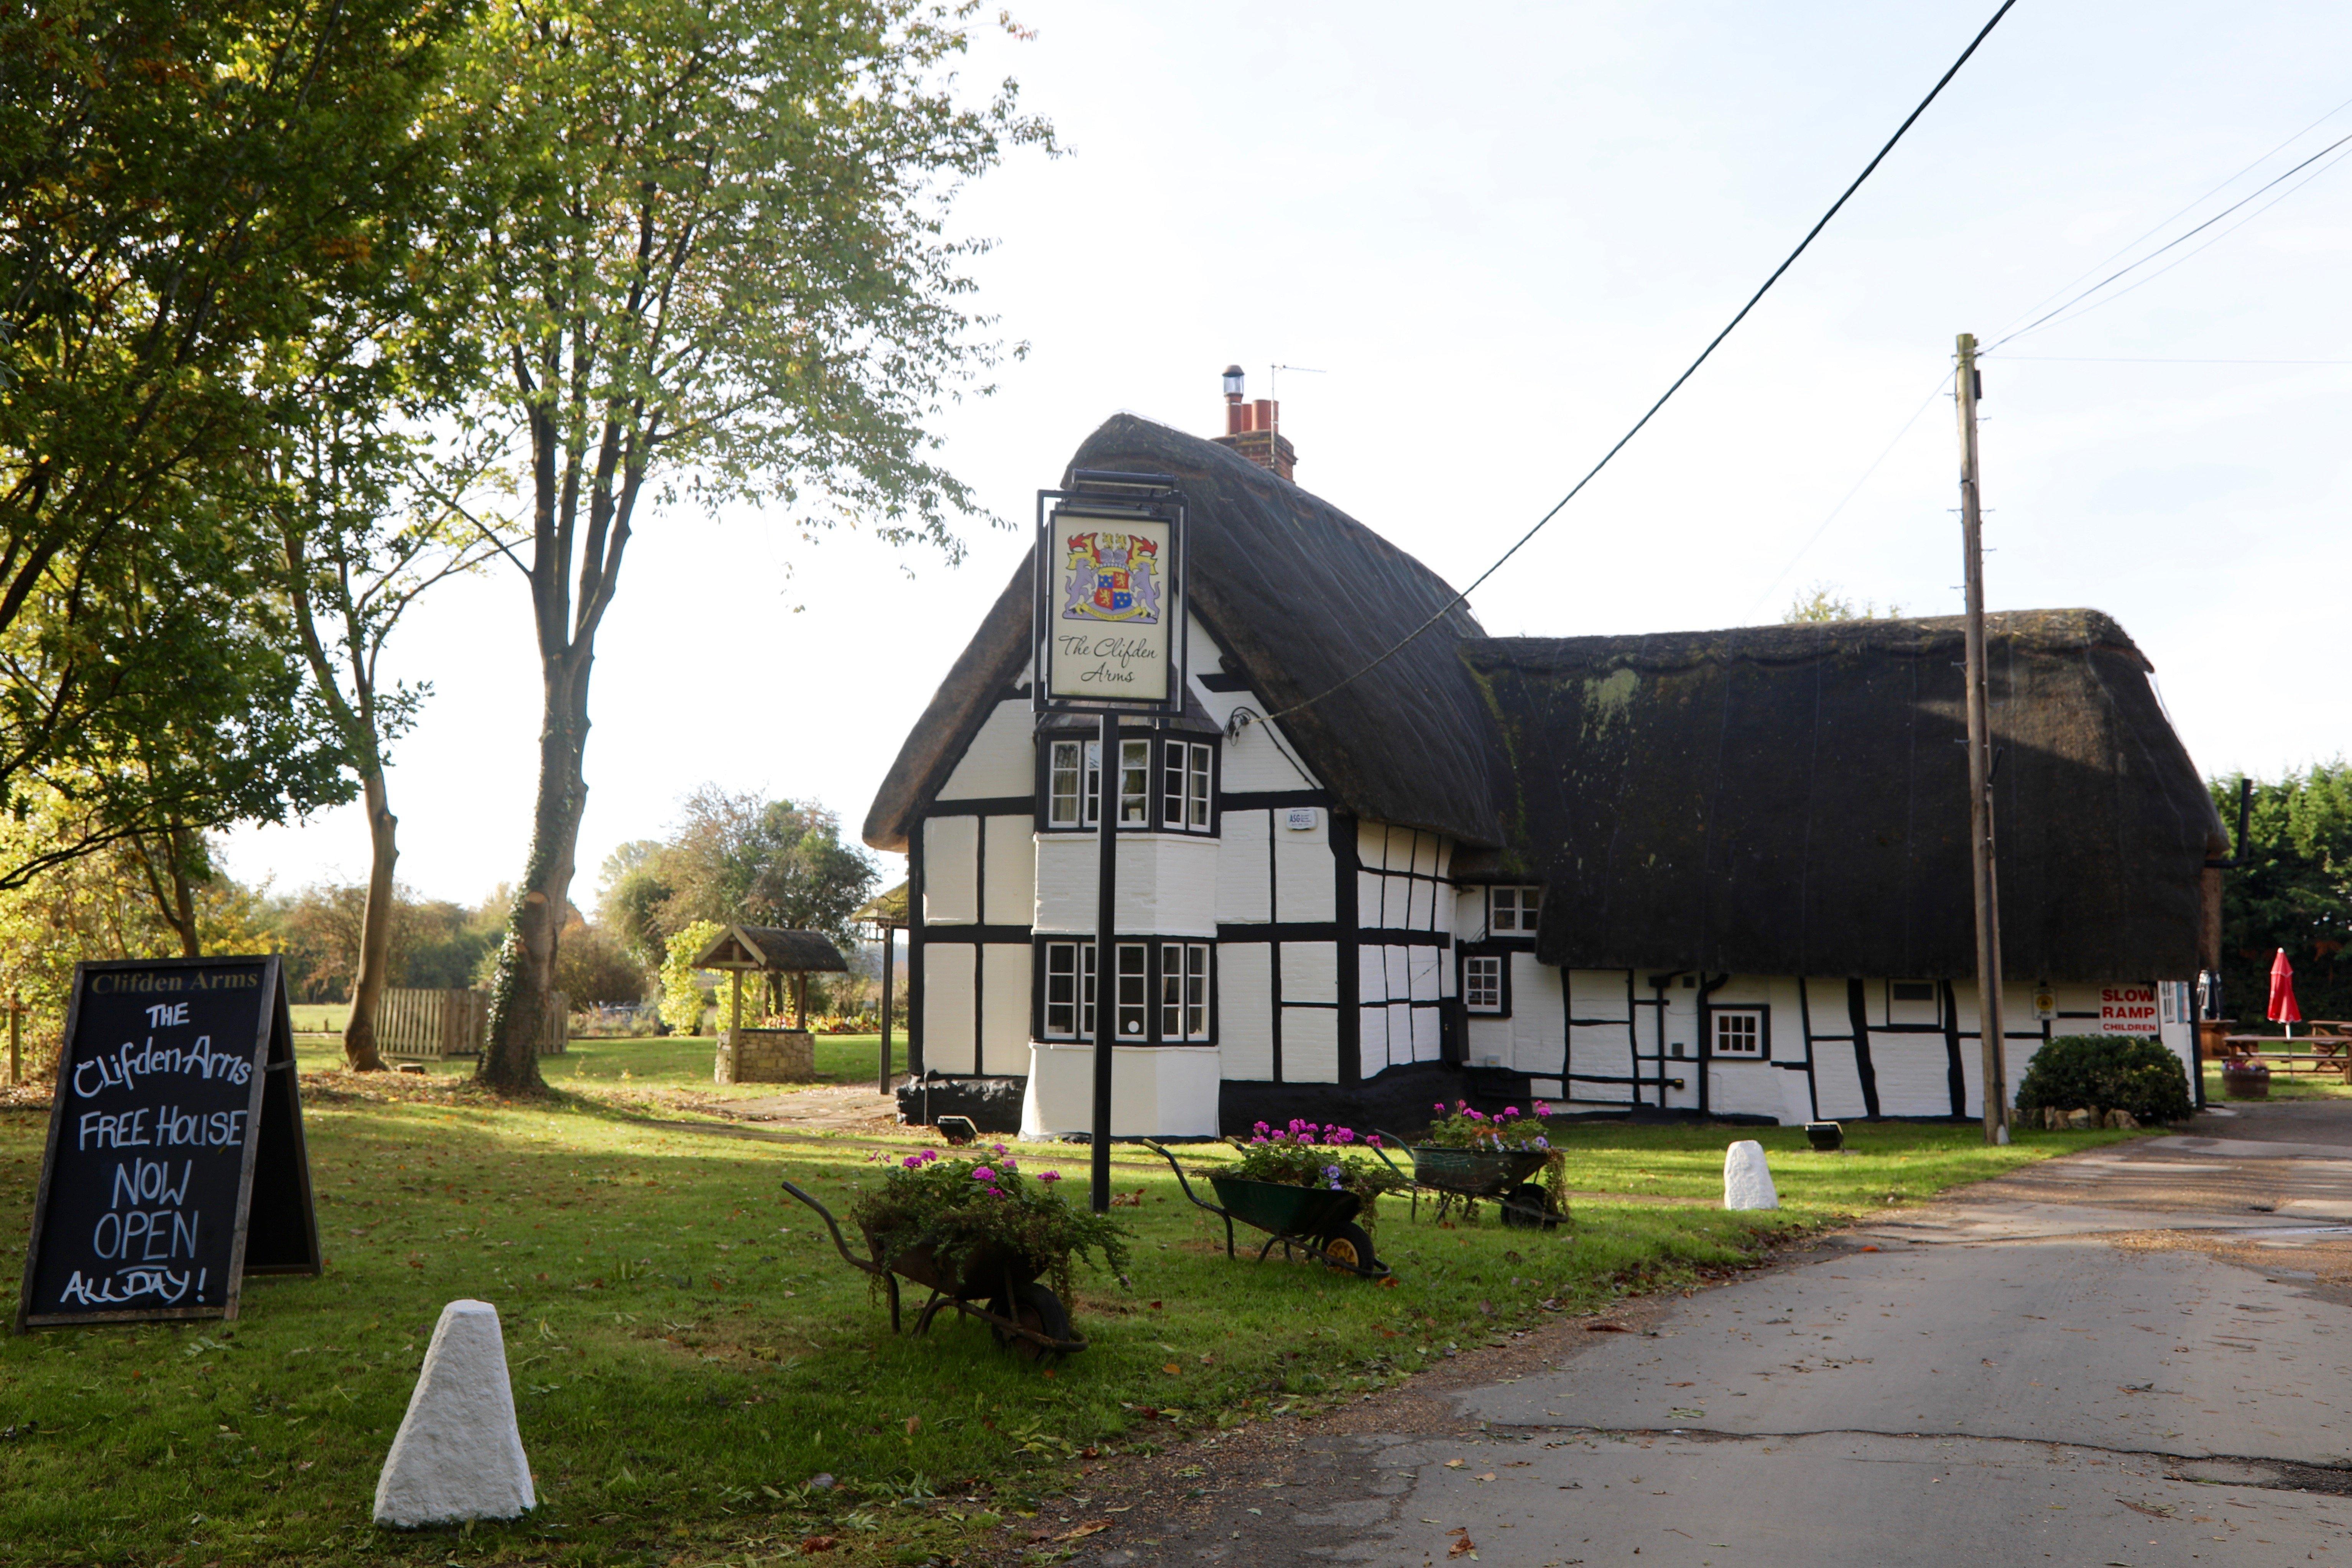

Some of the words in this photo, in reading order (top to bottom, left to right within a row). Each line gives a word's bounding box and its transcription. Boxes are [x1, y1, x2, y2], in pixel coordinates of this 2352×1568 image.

[1058, 635, 1090, 655] The
[1094, 637, 1158, 668] Clifden
[1081, 661, 1135, 683] Arms
[92, 972, 183, 994] Clifden
[190, 971, 259, 990] Arms
[2102, 989, 2155, 1002] SLOW
[145, 1002, 190, 1028] THE
[2102, 1006, 2155, 1018] RAMP
[2103, 1023, 2156, 1031] CHILDREN
[182, 1035, 252, 1085] Arms
[79, 1107, 150, 1151] FREE
[156, 1105, 248, 1147] HOUSE
[111, 1157, 192, 1209] NOW
[93, 1209, 199, 1260] OPEN
[59, 1270, 131, 1305] ALL
